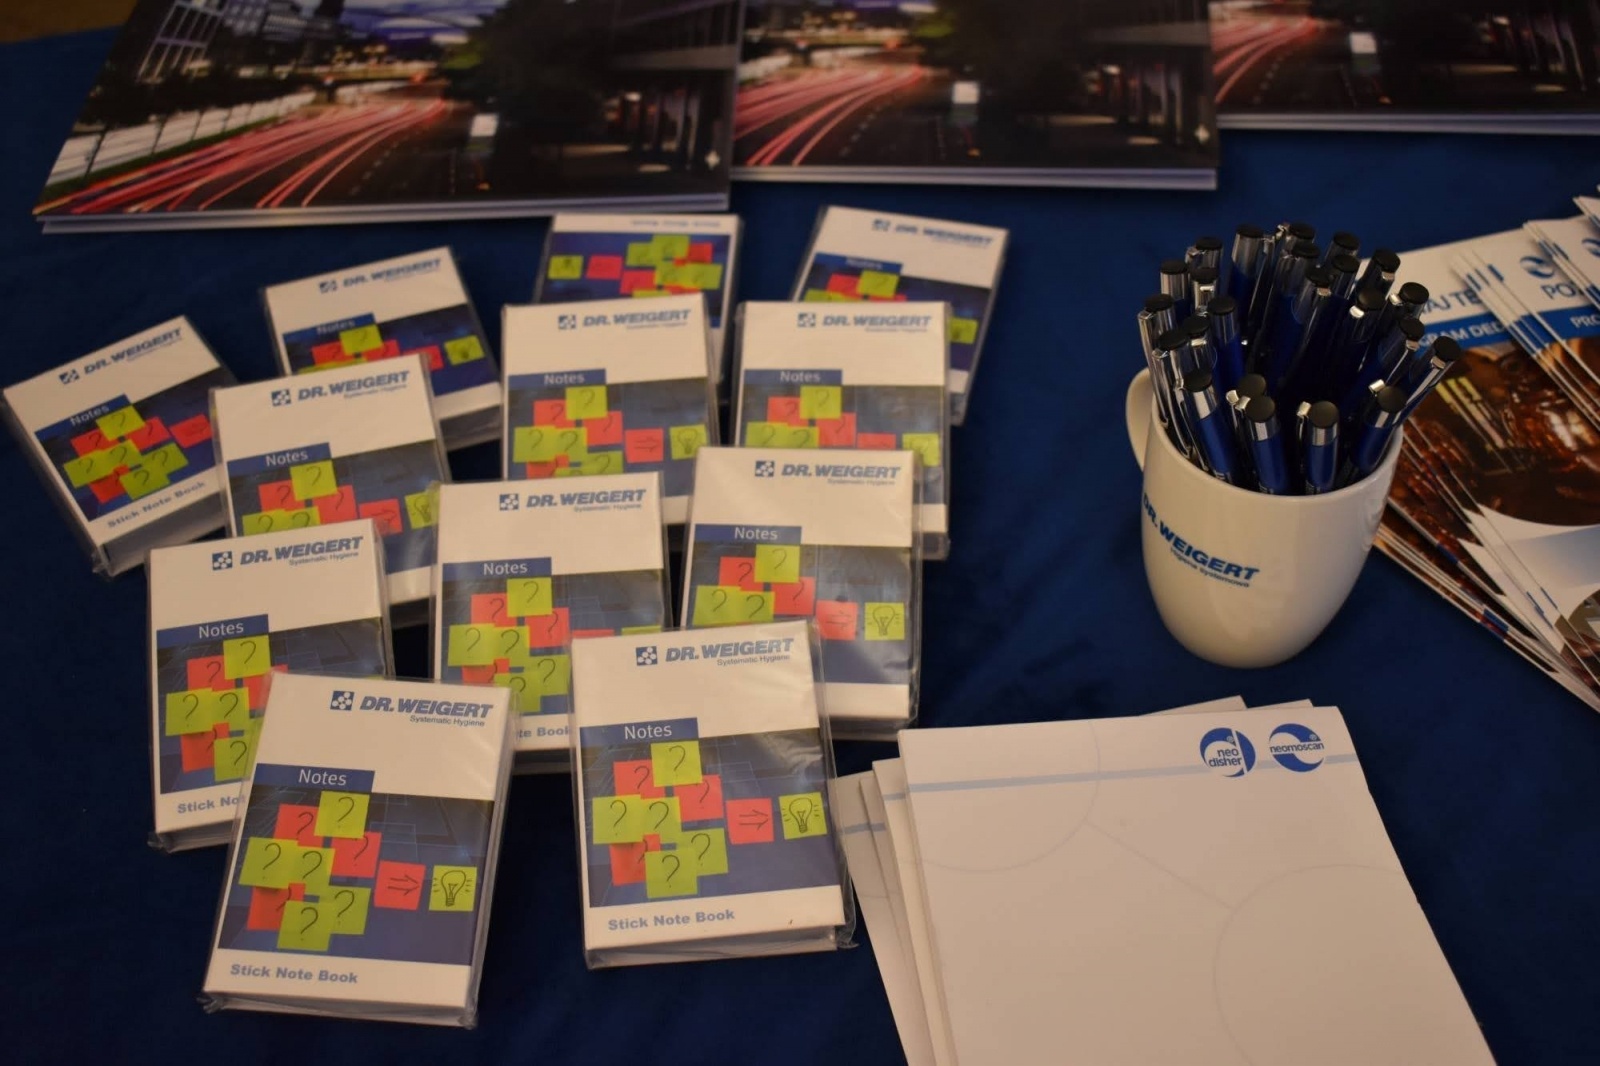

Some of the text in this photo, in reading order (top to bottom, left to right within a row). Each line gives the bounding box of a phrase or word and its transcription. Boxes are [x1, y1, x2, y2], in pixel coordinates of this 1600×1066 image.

[613, 308, 692, 324] WEIGERT
[853, 314, 932, 327] WEIGERT
[544, 372, 586, 386] Notes
[780, 371, 821, 383] Notes
[297, 370, 410, 401] DR. WEIGERT
[70, 406, 110, 426] Notes
[266, 450, 309, 467] Notes
[781, 463, 901, 479] DR. WEIGERT
[526, 489, 647, 508] DR. WEIGERT
[734, 527, 778, 541] Notes
[240, 536, 364, 565] DR. WEIGERT
[1160, 519, 1260, 581] WEIGERT
[483, 562, 528, 576] Notes
[198, 621, 244, 639] Notes
[665, 638, 794, 662] DR. WEIGERT
[360, 696, 494, 719] DR. WEIGERT
[410, 714, 485, 727] Systematic Hygiene
[624, 724, 673, 740] Notes
[1217, 748, 1240, 758] neo
[1269, 742, 1325, 753] neomoscan
[1208, 757, 1243, 767] disher
[298, 768, 347, 786] Notes
[177, 799, 215, 814] Stick
[607, 908, 735, 931] Stick Note Book
[230, 963, 358, 984] Stick Note Book
